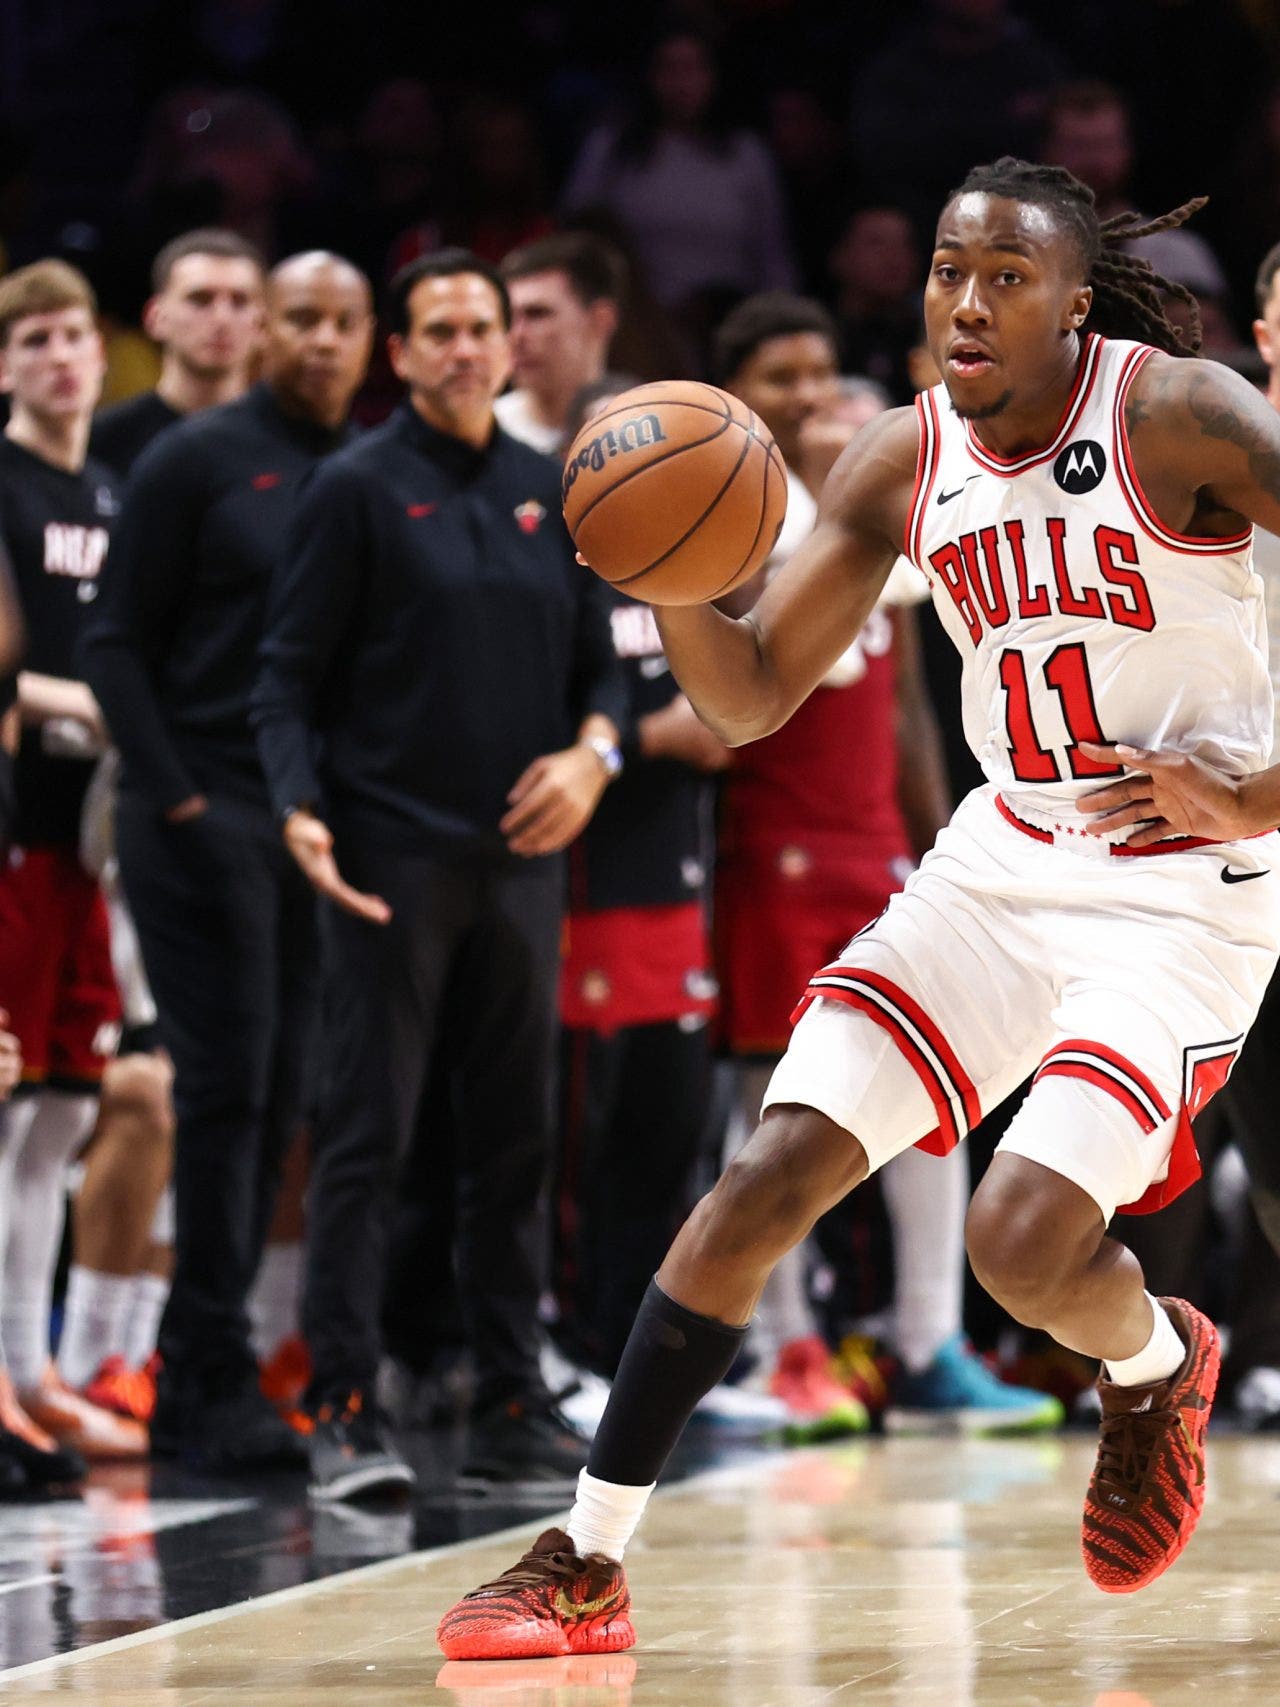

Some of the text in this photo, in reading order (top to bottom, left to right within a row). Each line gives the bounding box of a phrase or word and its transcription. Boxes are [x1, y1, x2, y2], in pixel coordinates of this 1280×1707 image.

[562, 413, 667, 503] Wilso
[928, 517, 1157, 650] BULLS
[998, 641, 1125, 783] 11
